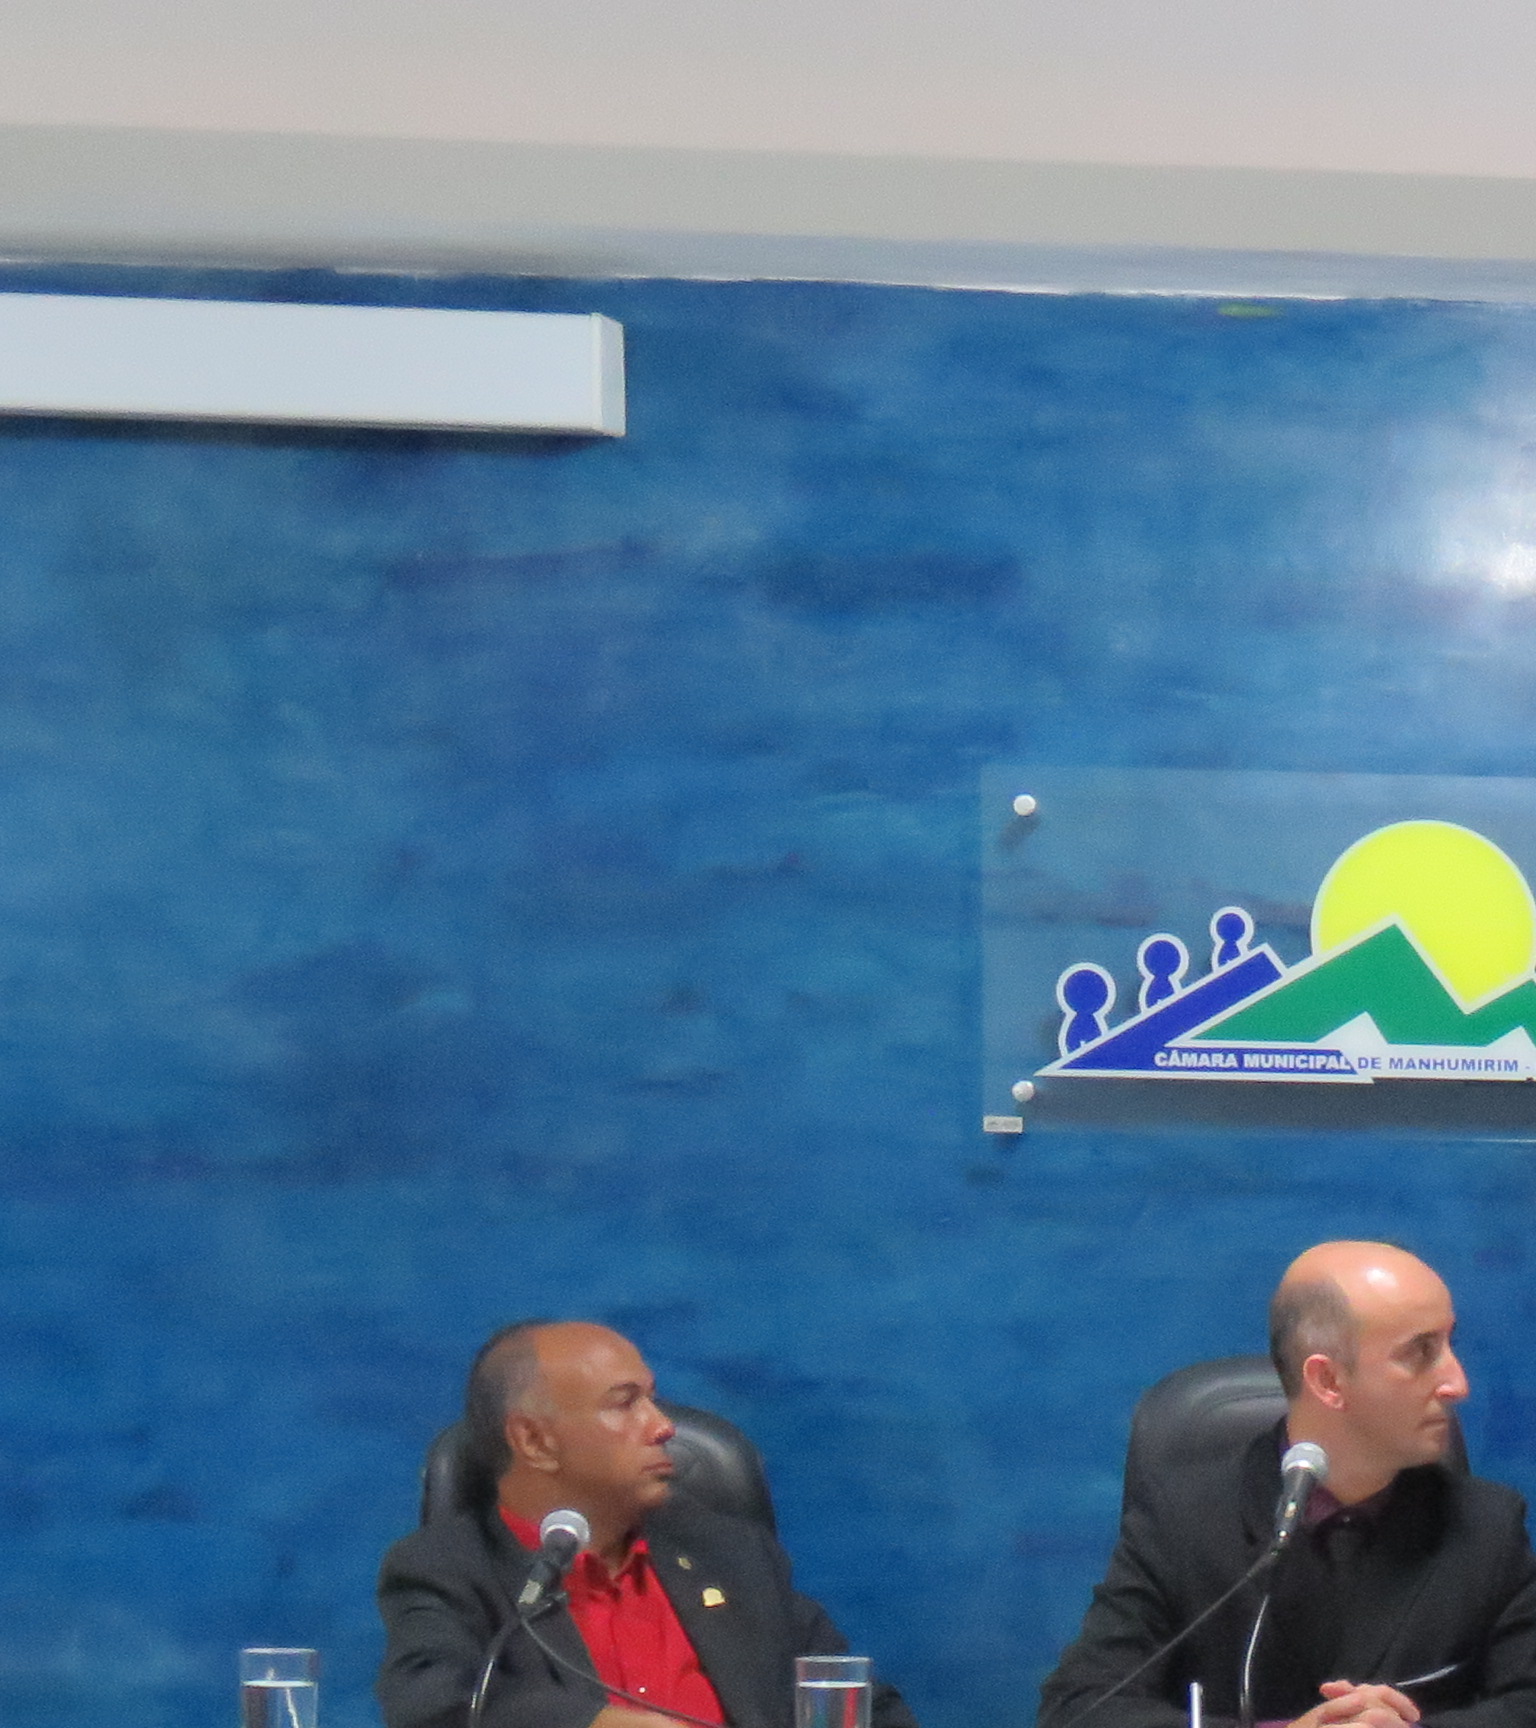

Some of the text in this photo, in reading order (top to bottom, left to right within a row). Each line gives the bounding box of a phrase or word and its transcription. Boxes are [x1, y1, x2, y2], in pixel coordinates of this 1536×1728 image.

[1153, 1050, 1239, 1068] CÂMARA
[1243, 1053, 1350, 1070] MUNICIPAL
[1357, 1057, 1381, 1069] DE
[1388, 1057, 1519, 1073] MANHUMIRIM
